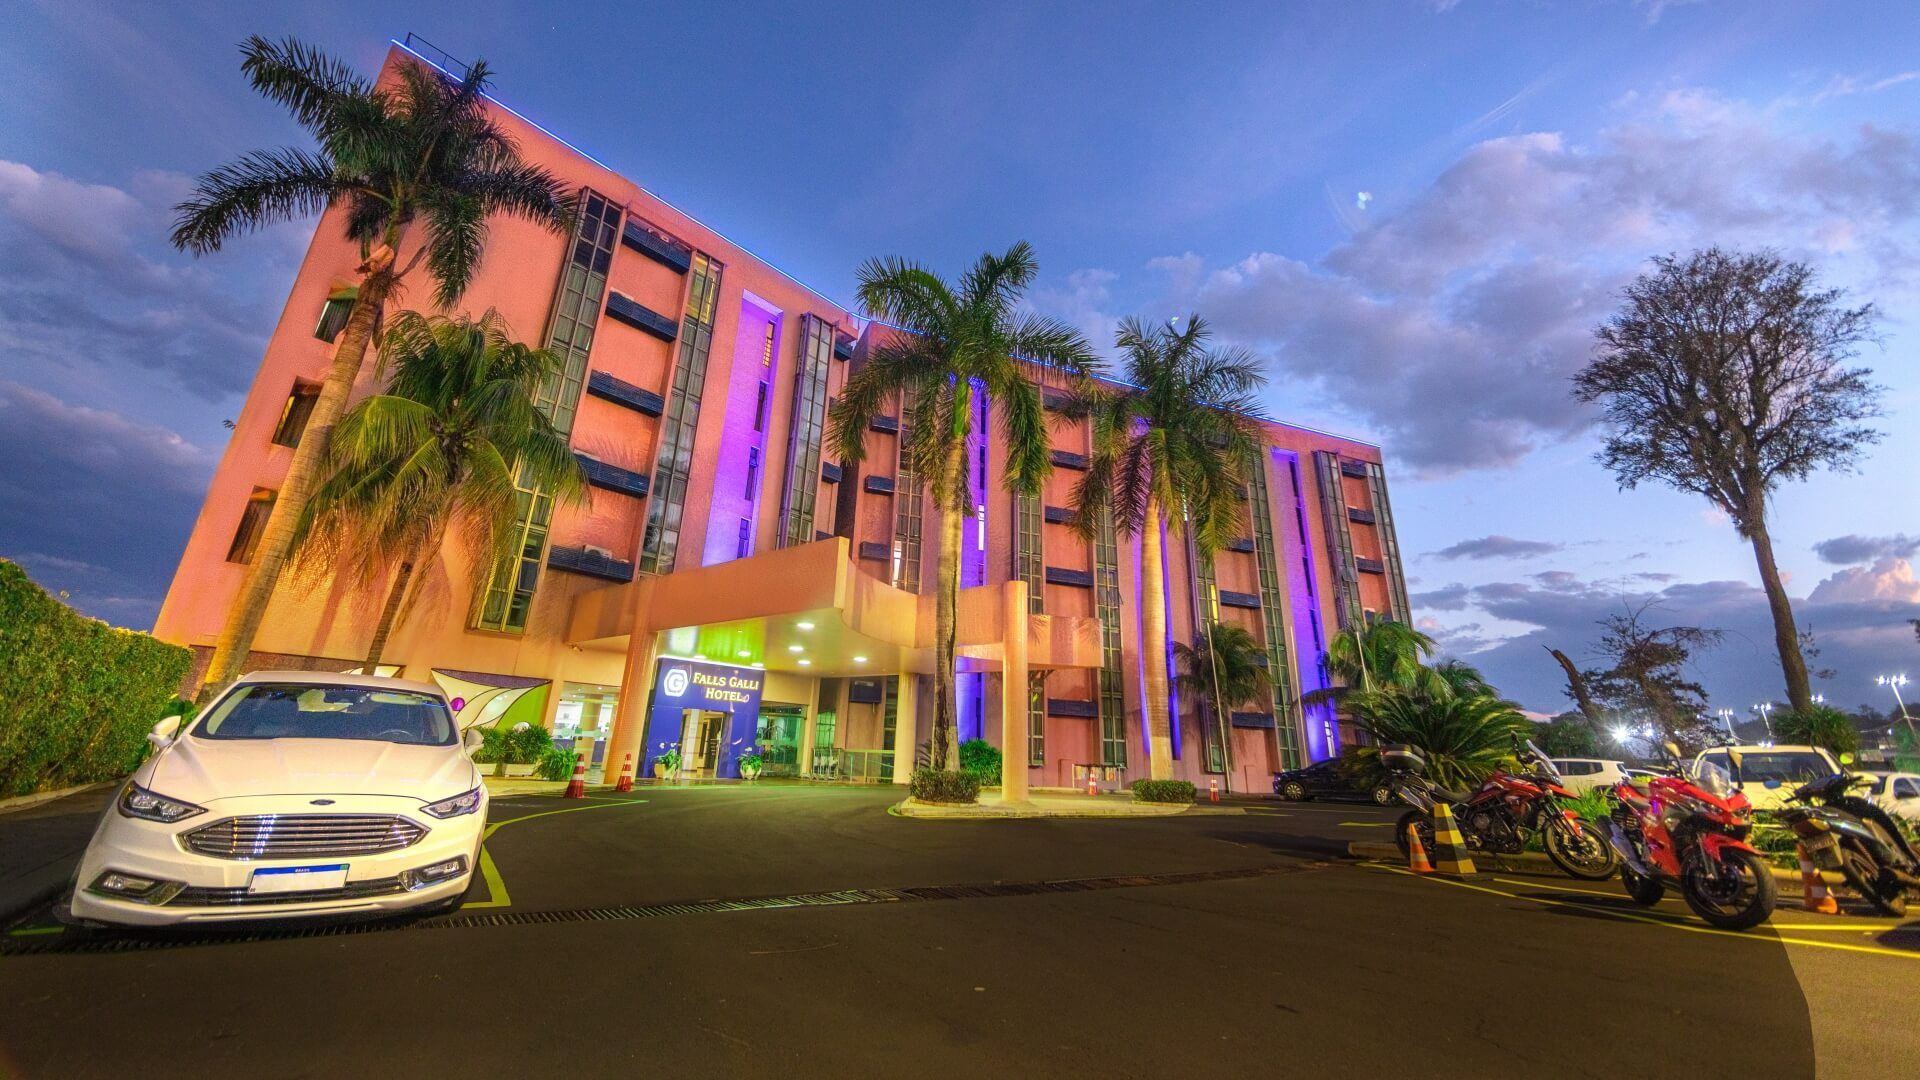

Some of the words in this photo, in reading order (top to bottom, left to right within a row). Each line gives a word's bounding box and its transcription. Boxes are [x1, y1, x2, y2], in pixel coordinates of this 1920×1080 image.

[693, 672, 727, 686] FALLS
[729, 676, 759, 690] GALLI
[705, 687, 743, 702] HOTEL
